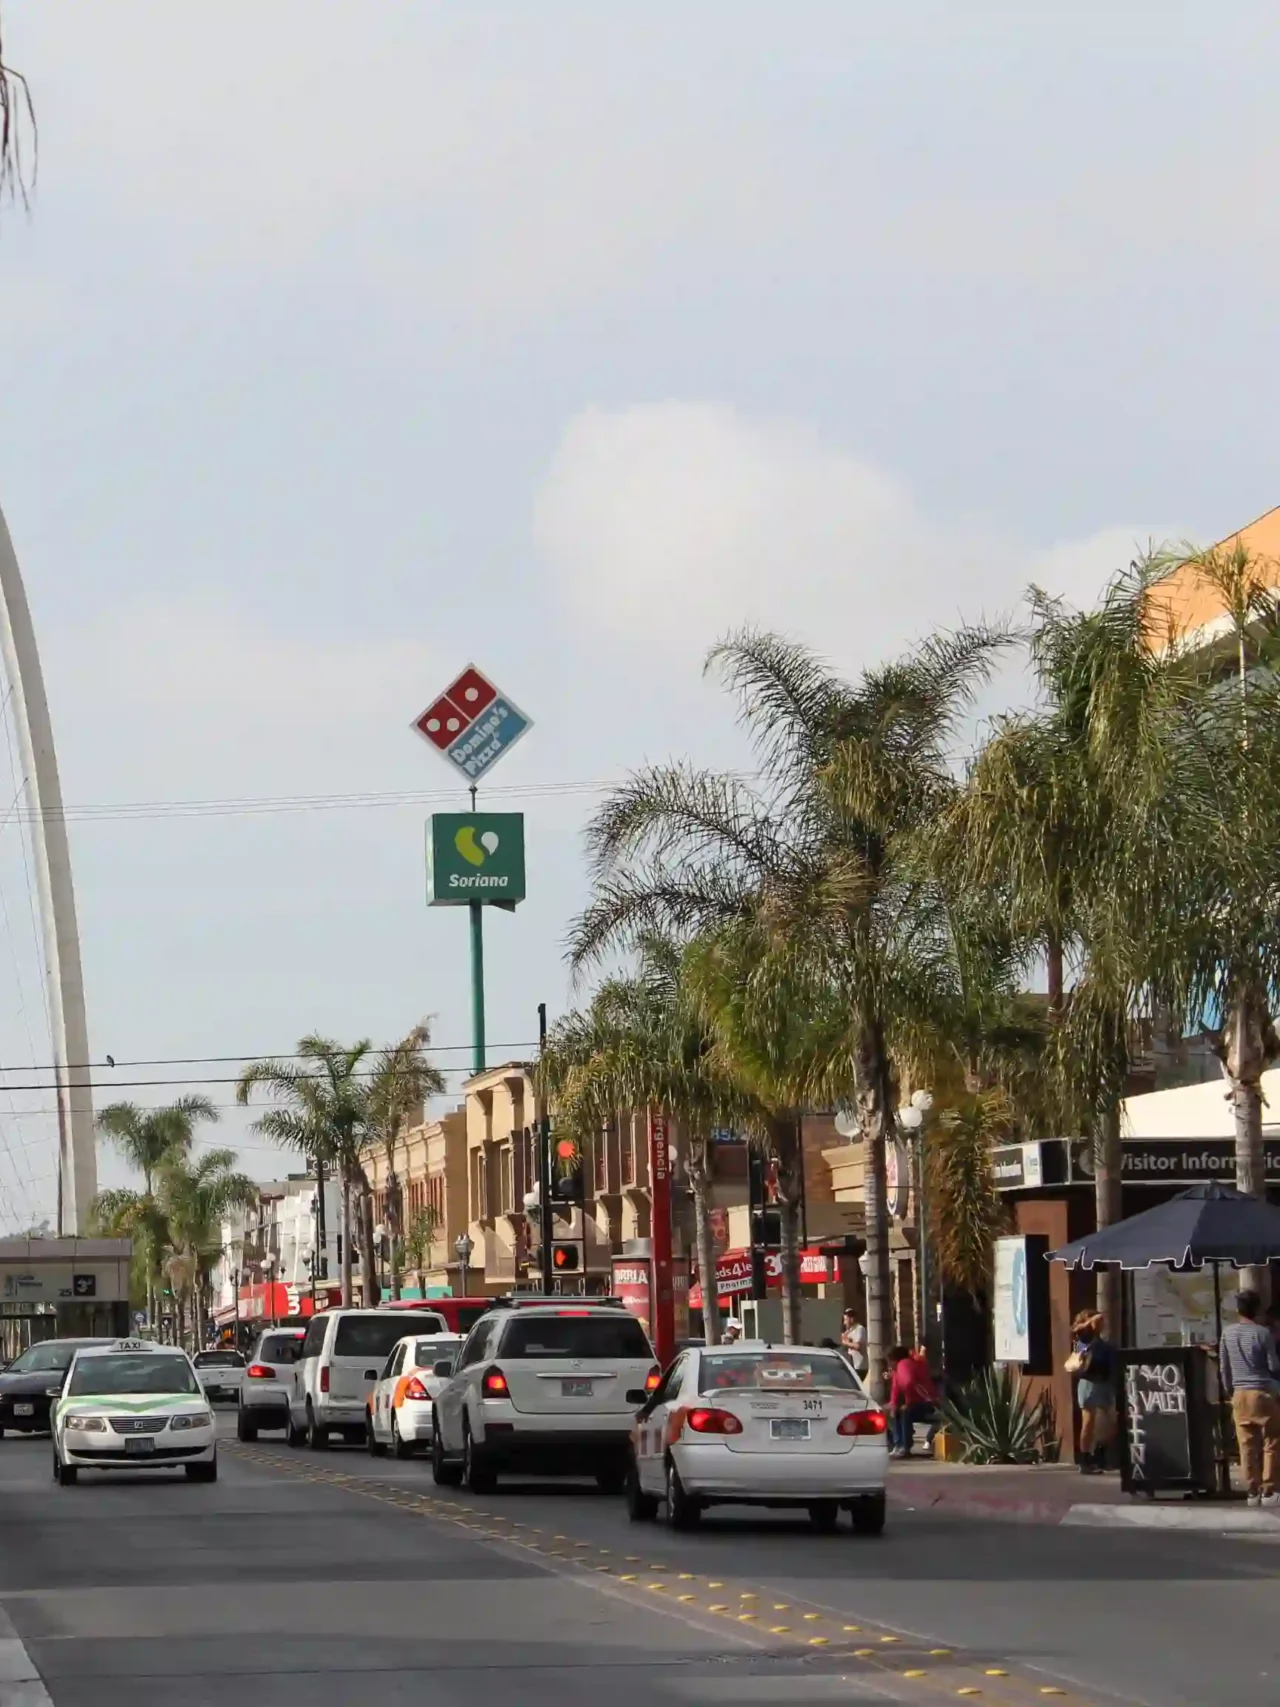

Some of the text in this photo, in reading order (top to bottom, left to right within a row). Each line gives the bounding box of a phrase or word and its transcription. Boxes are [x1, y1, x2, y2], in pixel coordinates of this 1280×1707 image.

[451, 705, 508, 763] Domino's
[463, 740, 501, 775] Pizza
[449, 873, 508, 887] Soriana
[654, 1112, 667, 1180] ergencia
[119, 1341, 141, 1349] TAXI
[803, 1400, 822, 1410] 3471
[1138, 1390, 1187, 1413] VALET
